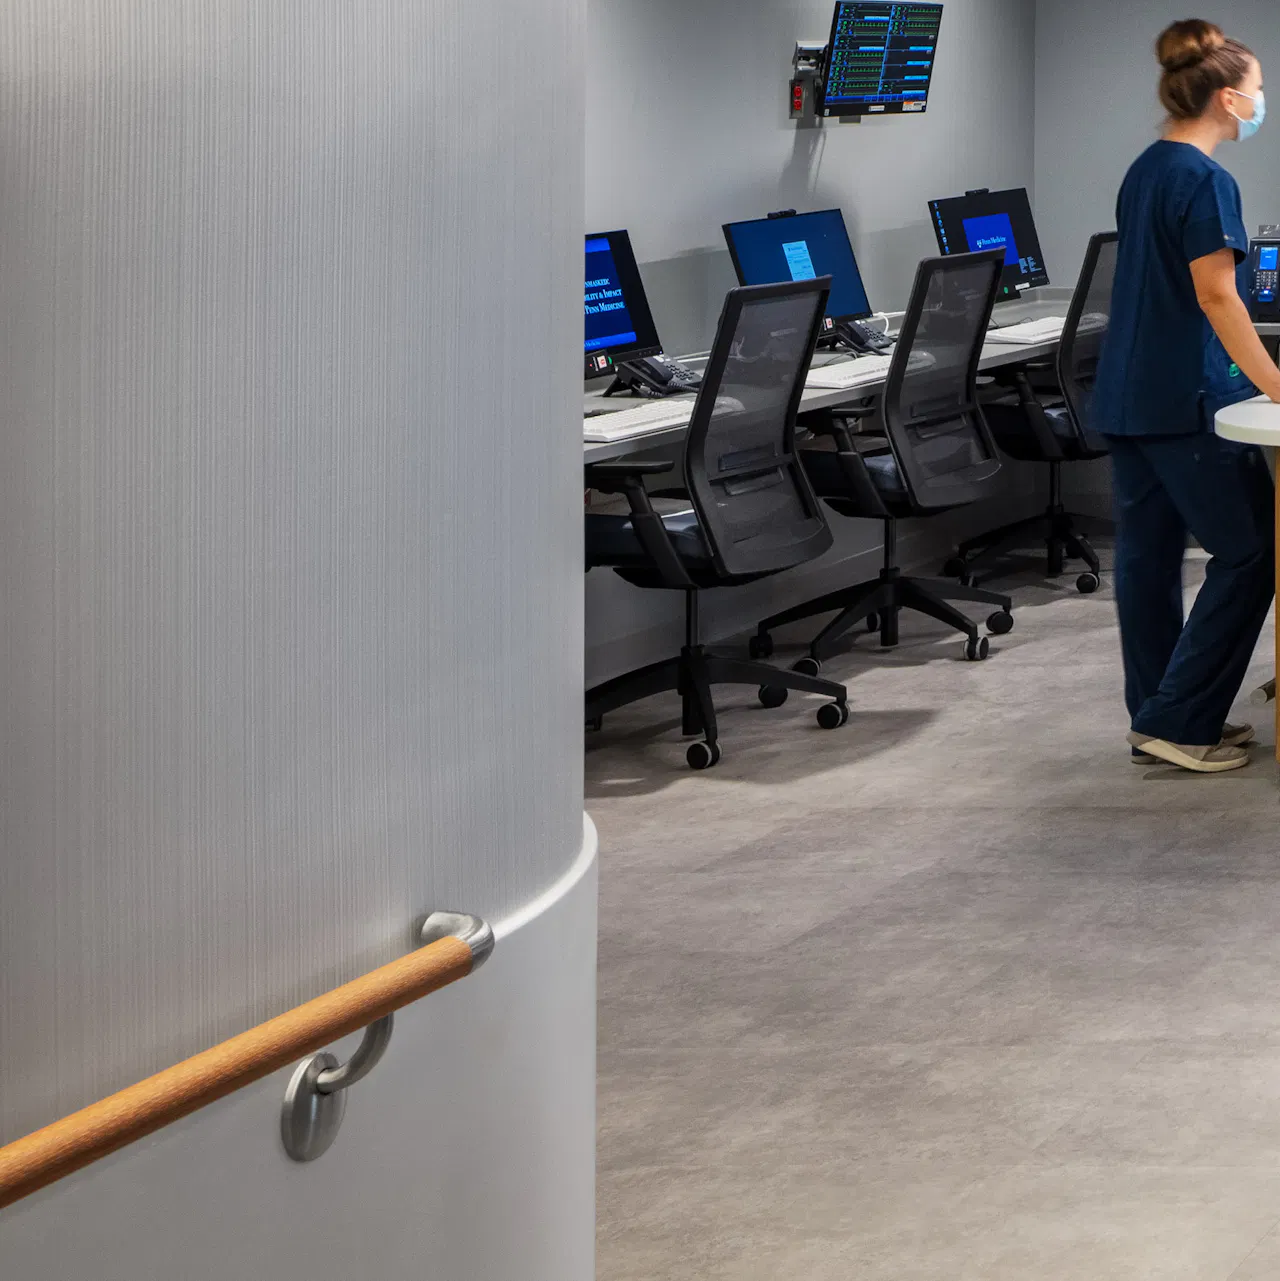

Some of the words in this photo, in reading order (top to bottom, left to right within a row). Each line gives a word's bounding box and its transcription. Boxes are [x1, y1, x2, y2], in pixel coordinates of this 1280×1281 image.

[602, 289, 622, 298] IMPACT
[584, 305, 600, 315] PENN
[598, 301, 626, 313] MEDICINE
